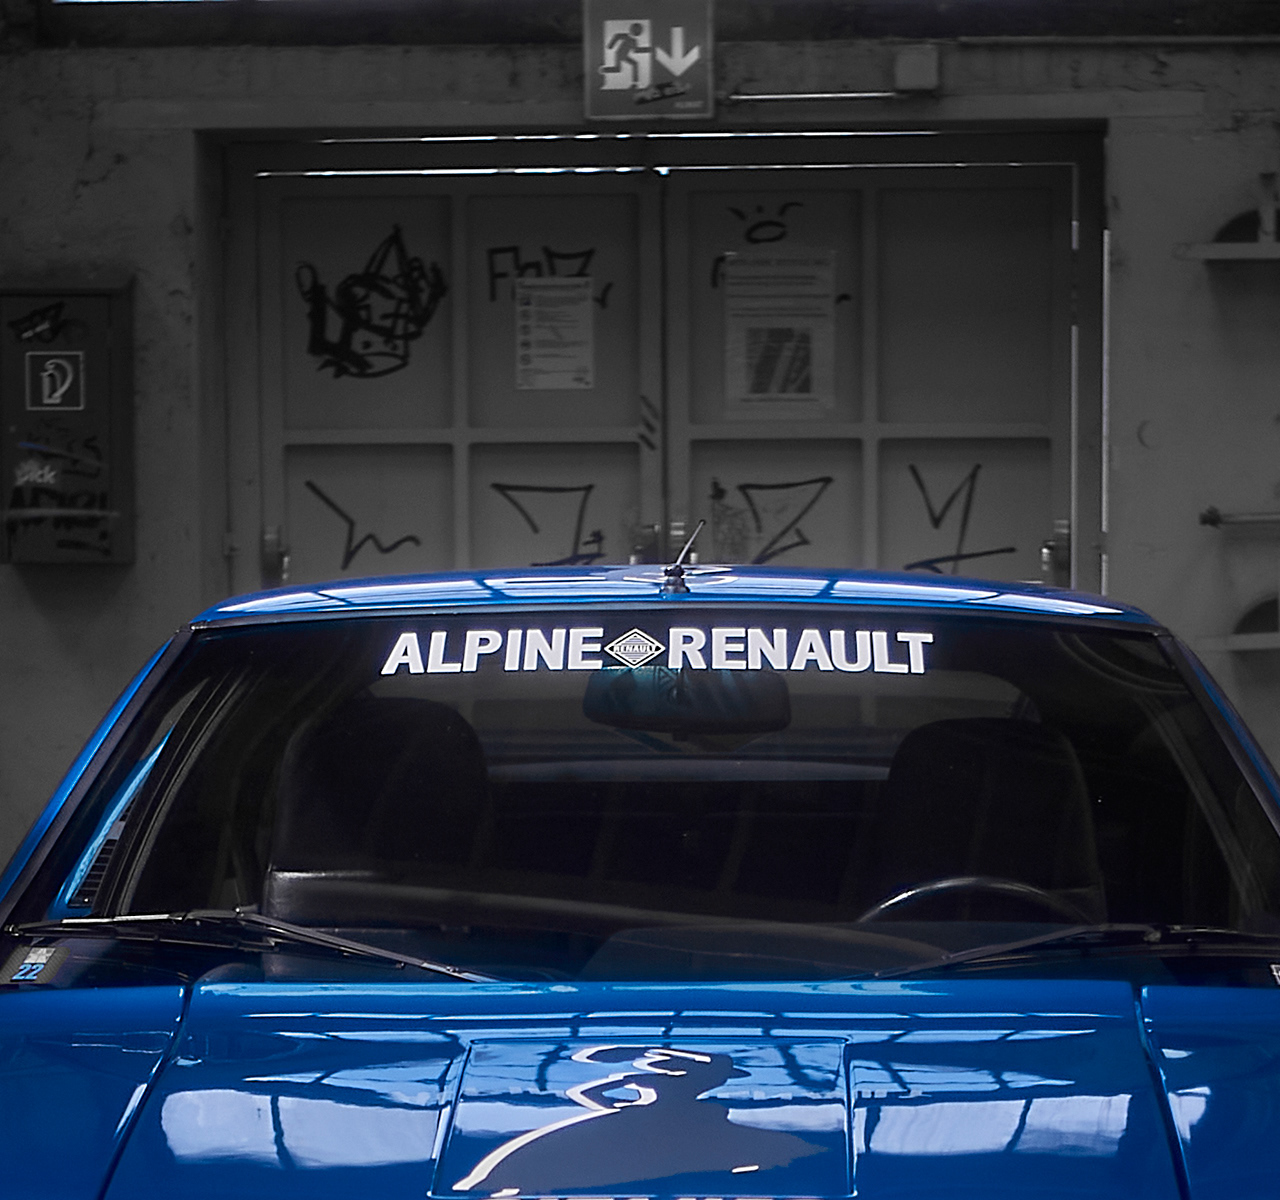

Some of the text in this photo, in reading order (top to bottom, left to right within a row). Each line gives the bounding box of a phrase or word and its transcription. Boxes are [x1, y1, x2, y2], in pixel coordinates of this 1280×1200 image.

[381, 627, 934, 675] ALPINE RENAULT
[613, 645, 657, 653] RENAULT
[10, 963, 45, 982] 22
